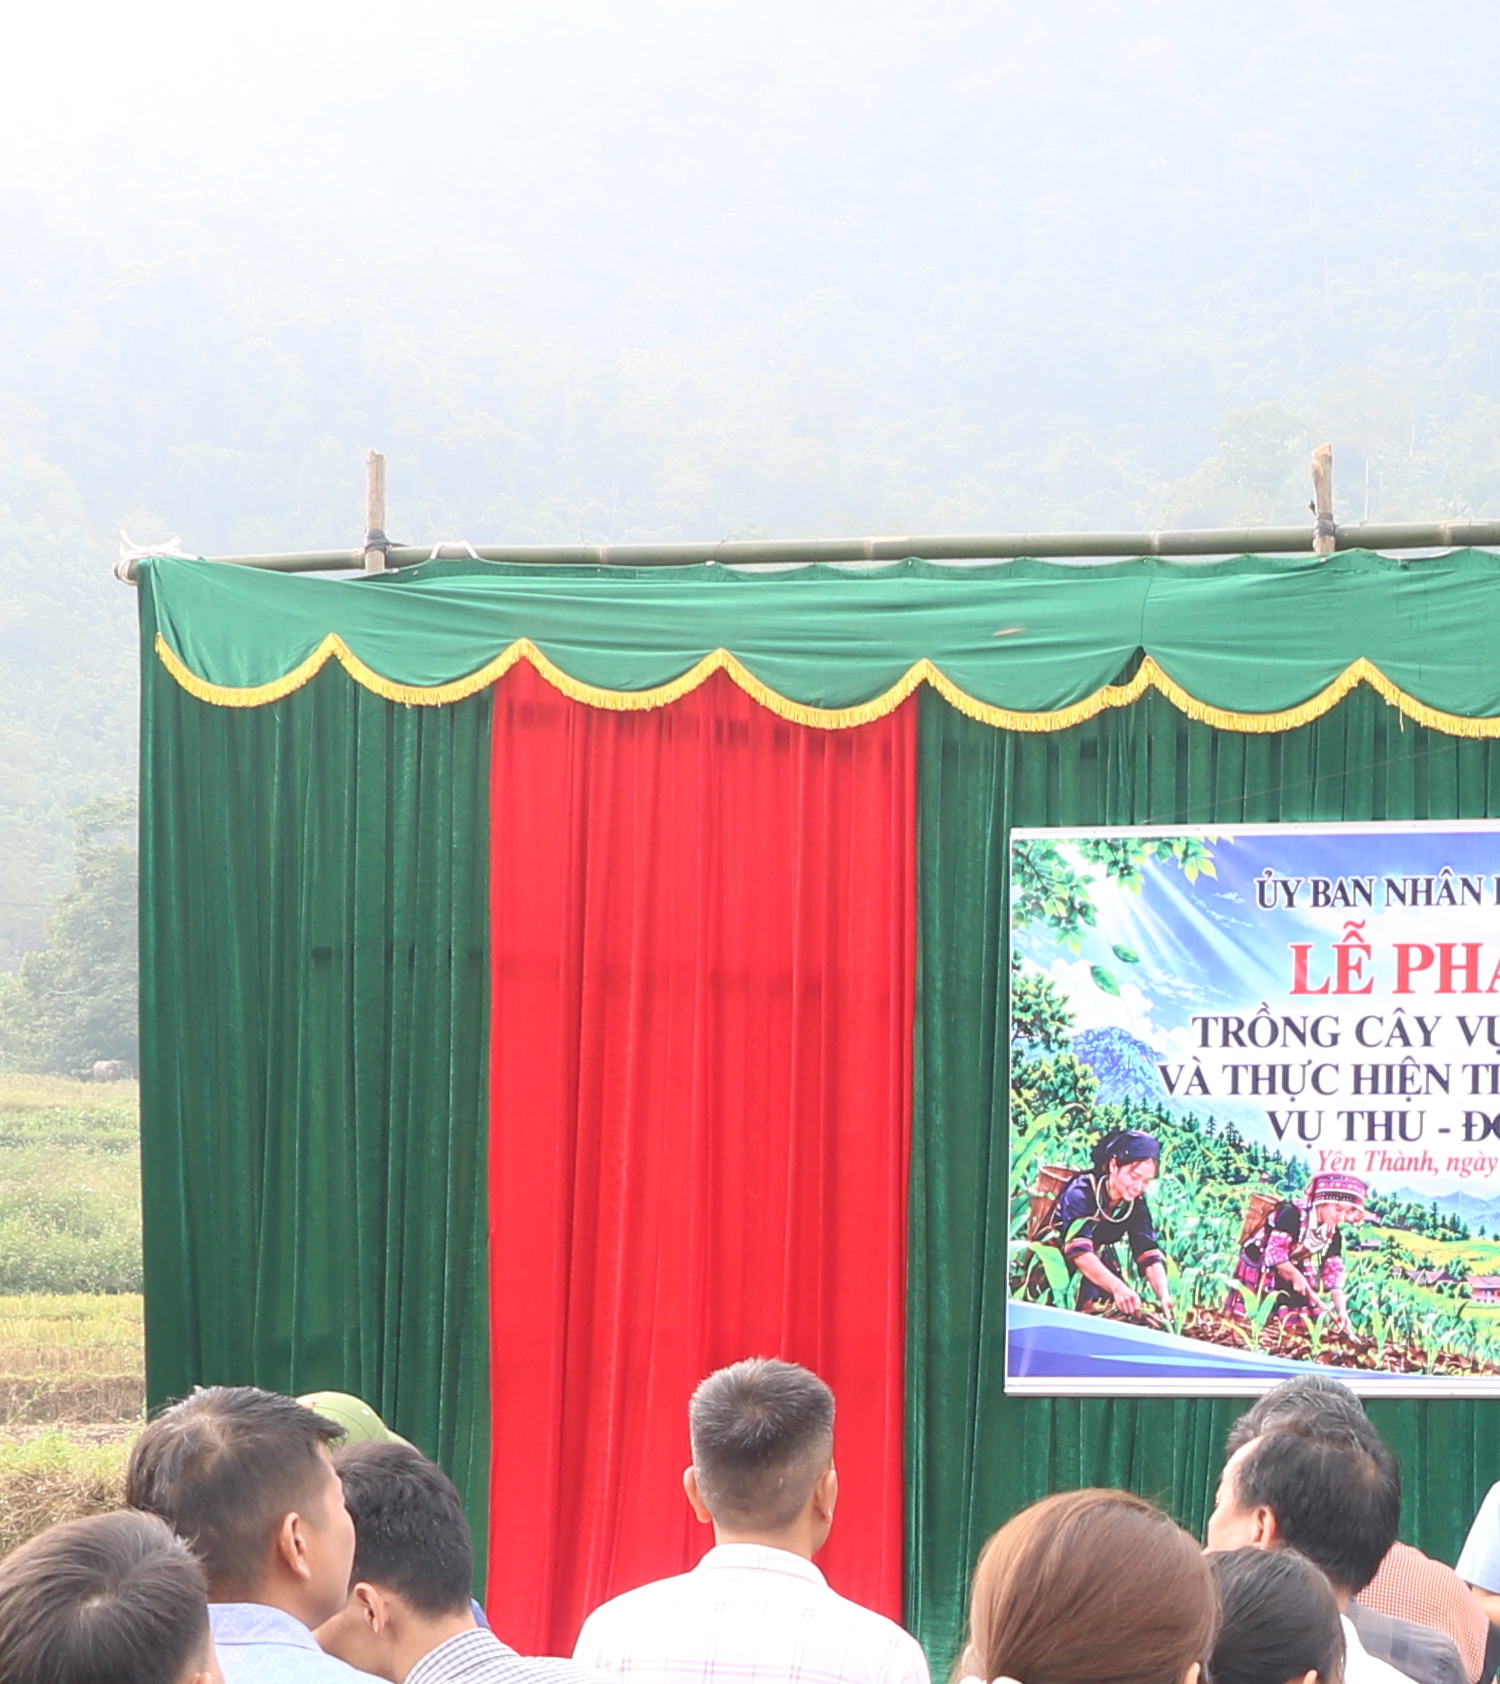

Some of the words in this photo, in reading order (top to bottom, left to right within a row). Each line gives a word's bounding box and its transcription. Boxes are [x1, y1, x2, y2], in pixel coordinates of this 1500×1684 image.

[1257, 870, 1301, 908] ỦY
[1311, 879, 1373, 908] BAN
[1384, 868, 1483, 907] NHÂN
[1289, 919, 1374, 995] LỄ
[1191, 1002, 1341, 1048] TRỒNG
[1355, 1007, 1442, 1048] CÂY
[1158, 1055, 1212, 1096] VÀ
[1222, 1058, 1339, 1102] THỰC
[1351, 1055, 1452, 1102] HIỆN
[1266, 1110, 1324, 1149] VỤ
[1317, 1149, 1356, 1172] Yên
[1364, 1149, 1439, 1176] Thành,
[1446, 1150, 1498, 1178] ngày
